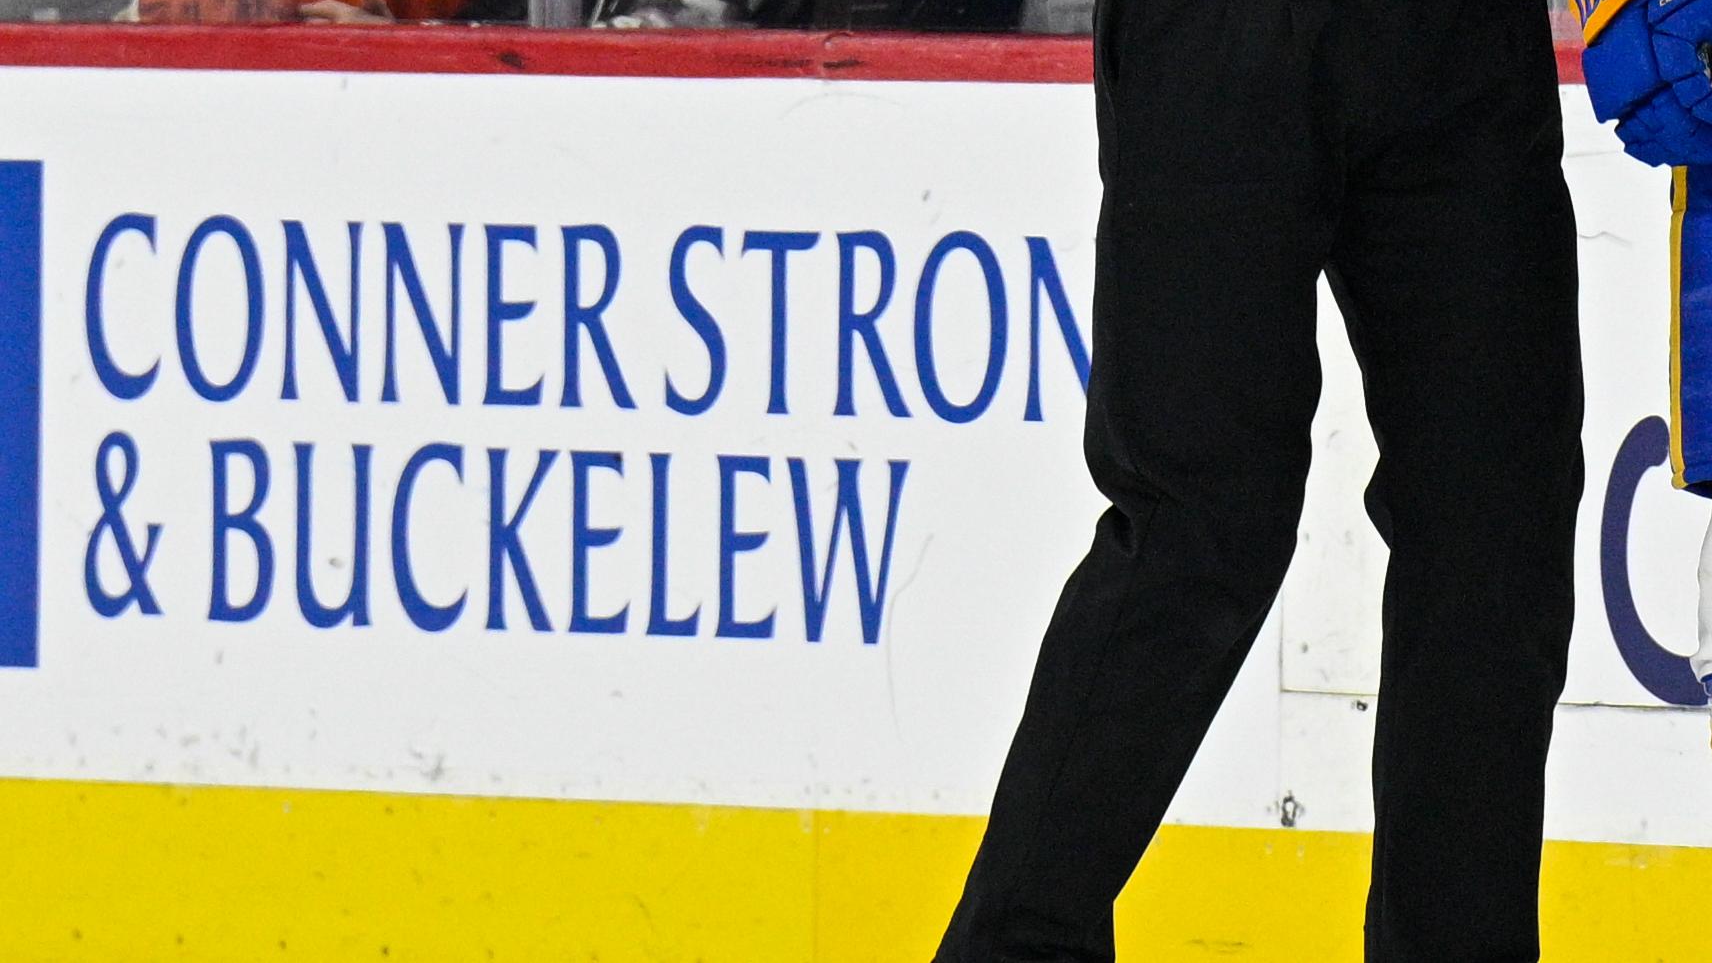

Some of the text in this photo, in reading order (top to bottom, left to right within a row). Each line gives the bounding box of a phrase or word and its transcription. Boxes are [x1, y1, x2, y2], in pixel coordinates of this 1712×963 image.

[85, 212, 1094, 425] CONNER STRON
[84, 431, 911, 646] & BUCKELEW
